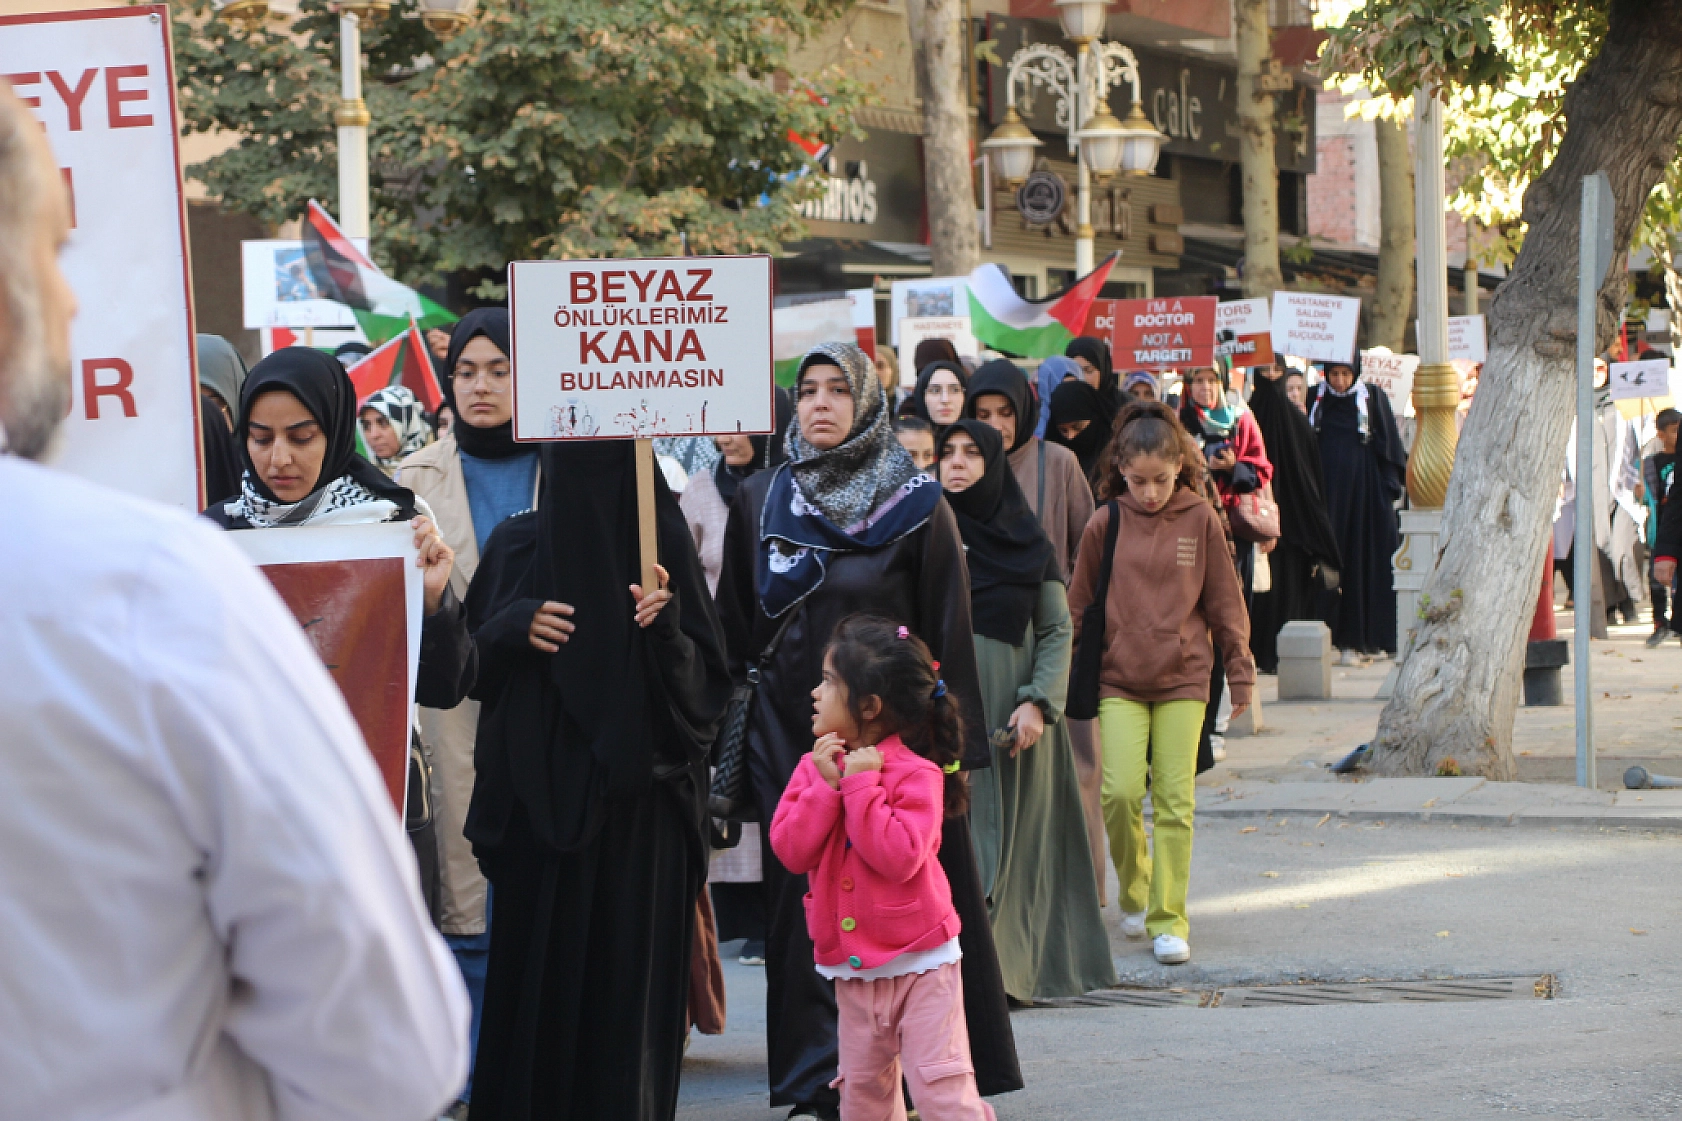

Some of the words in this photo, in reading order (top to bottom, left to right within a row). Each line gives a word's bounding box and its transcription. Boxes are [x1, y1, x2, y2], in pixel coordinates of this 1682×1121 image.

[569, 269, 714, 304] BEYAZ
[554, 302, 729, 327] ÖNLÜKLERİMİZ
[1147, 301, 1167, 312] I'M
[1172, 300, 1183, 312] A
[1134, 313, 1195, 328] DOCTOR
[579, 328, 707, 364] KANA
[1142, 333, 1170, 346] NOT
[1172, 332, 1184, 345] A
[1133, 348, 1193, 363] TARGET!
[560, 368, 724, 391] BULANMASIN
